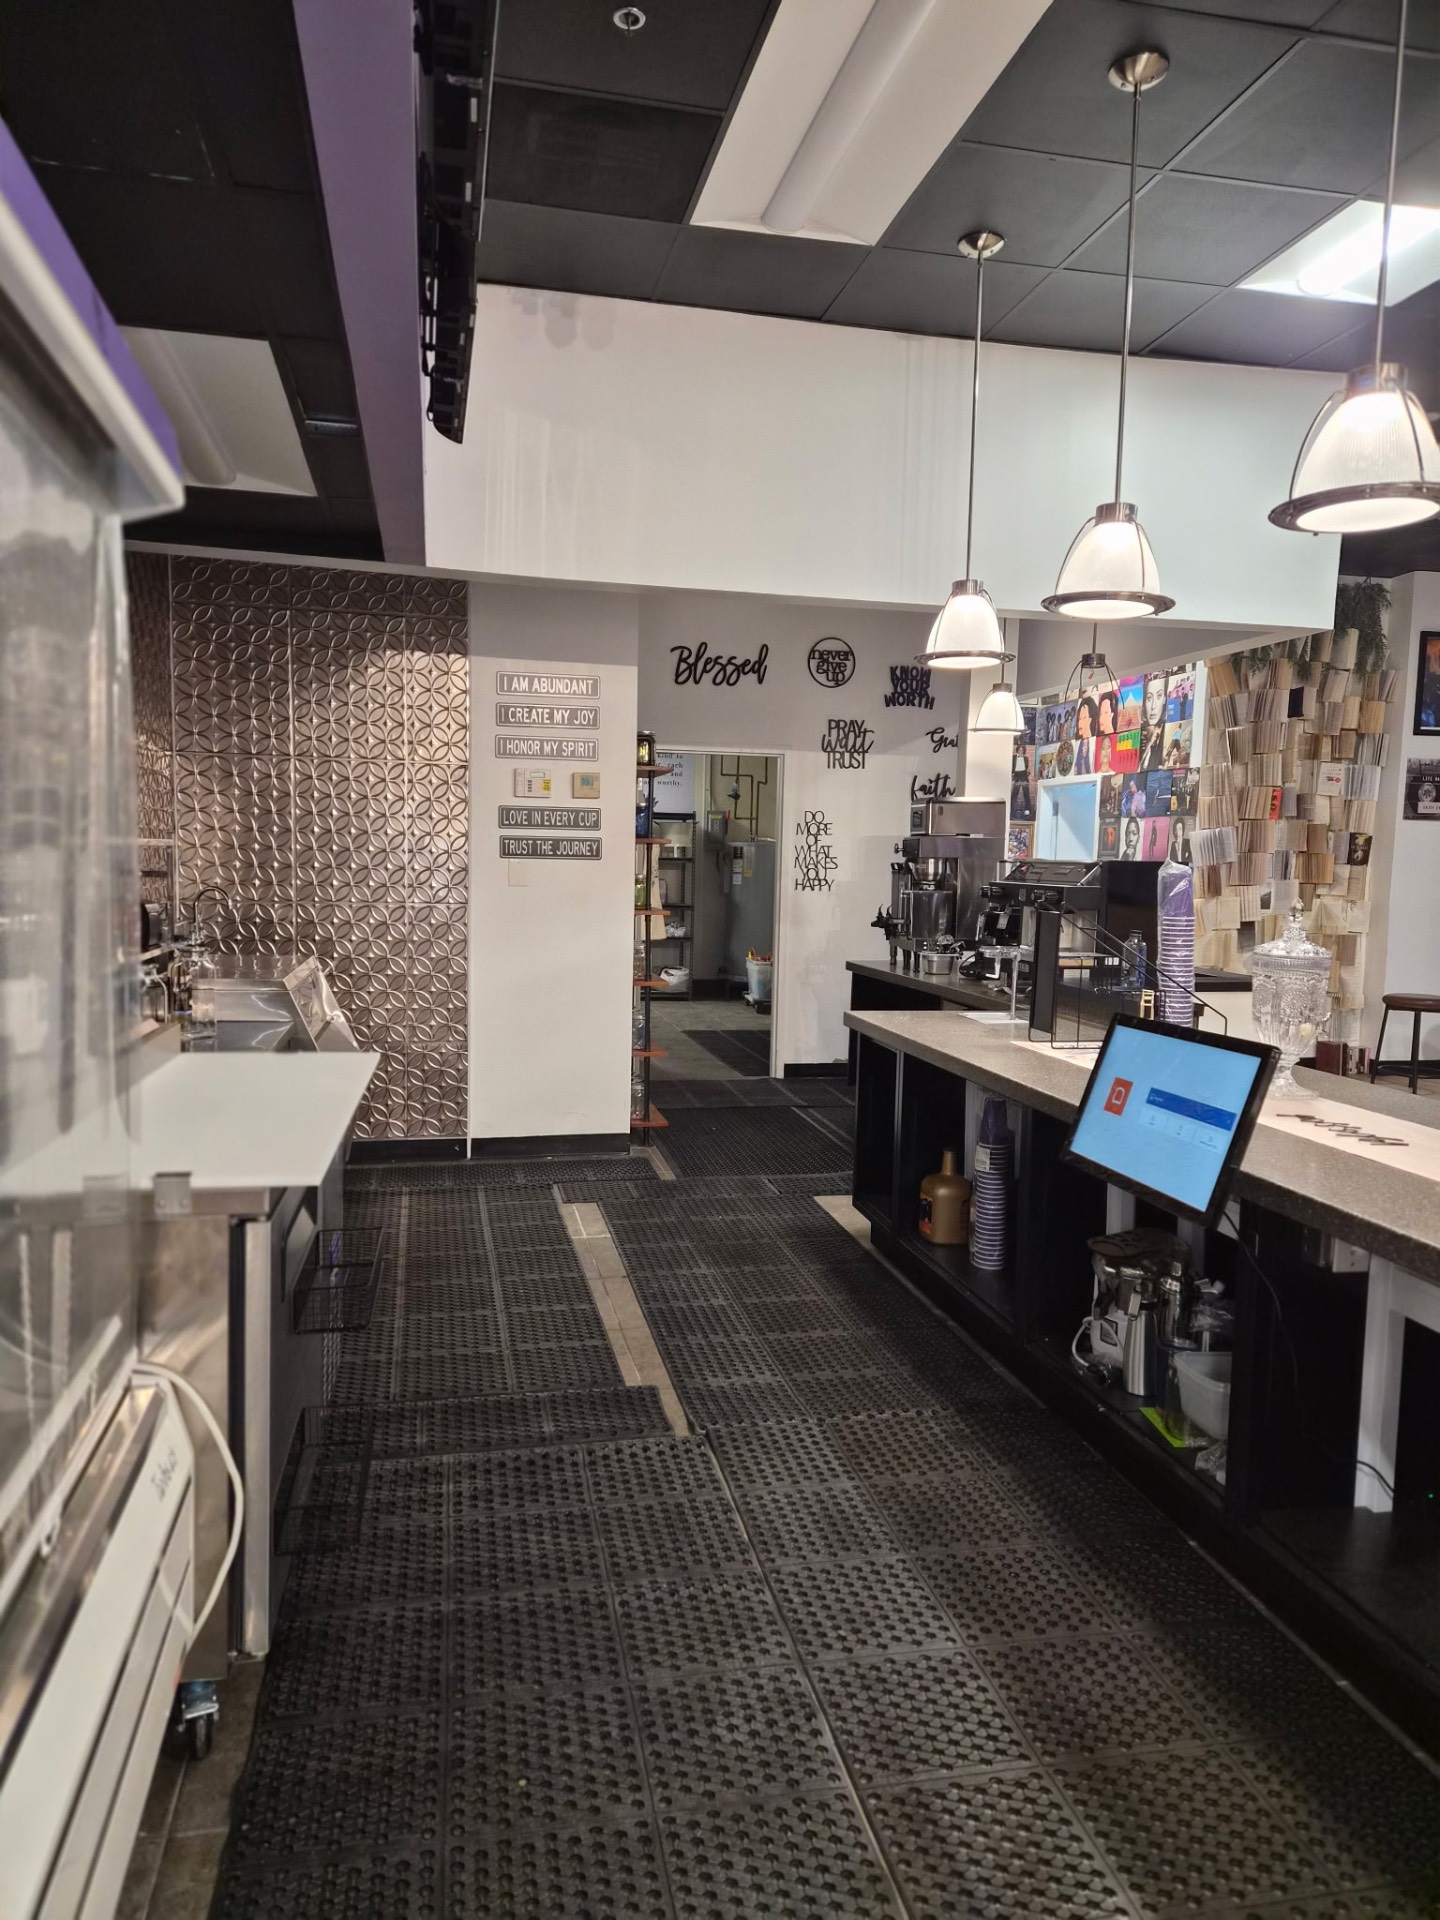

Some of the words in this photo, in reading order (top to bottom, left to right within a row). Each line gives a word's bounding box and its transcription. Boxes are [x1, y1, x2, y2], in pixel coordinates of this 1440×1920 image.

[811, 649, 852, 661] never
[670, 641, 769, 686] Blessed
[816, 660, 847, 674] give
[826, 671, 845, 686] up
[889, 665, 932, 681] KNOW
[503, 676, 508, 691] I
[511, 676, 529, 692] AM
[532, 677, 593, 695] ABUNDANT
[890, 679, 931, 695] YOUR
[884, 692, 936, 710] WORTH
[501, 707, 505, 721] I
[508, 707, 550, 723] CREATE
[553, 708, 570, 724] MY
[573, 710, 595, 725] JOY
[827, 718, 865, 738] PRAY
[500, 739, 504, 754] I
[506, 739, 541, 755] HONOR
[543, 740, 559, 756] MY
[561, 741, 594, 757] SPIRIT
[823, 750, 869, 769] TRUST
[911, 773, 956, 801] faith
[503, 809, 529, 825] LOVE
[531, 810, 542, 825] IN
[543, 811, 576, 826] EVERY
[578, 812, 598, 827] CUP
[804, 810, 825, 824] DO
[796, 822, 833, 836] MORE
[504, 839, 533, 854] TRUST
[536, 840, 553, 855] THE
[556, 840, 598, 856] JOURNEY
[806, 834, 822, 847] OF
[795, 845, 833, 858] WHAT
[794, 856, 838, 869] MAKES
[798, 867, 827, 881] YOU
[794, 879, 835, 891] HAPPY
